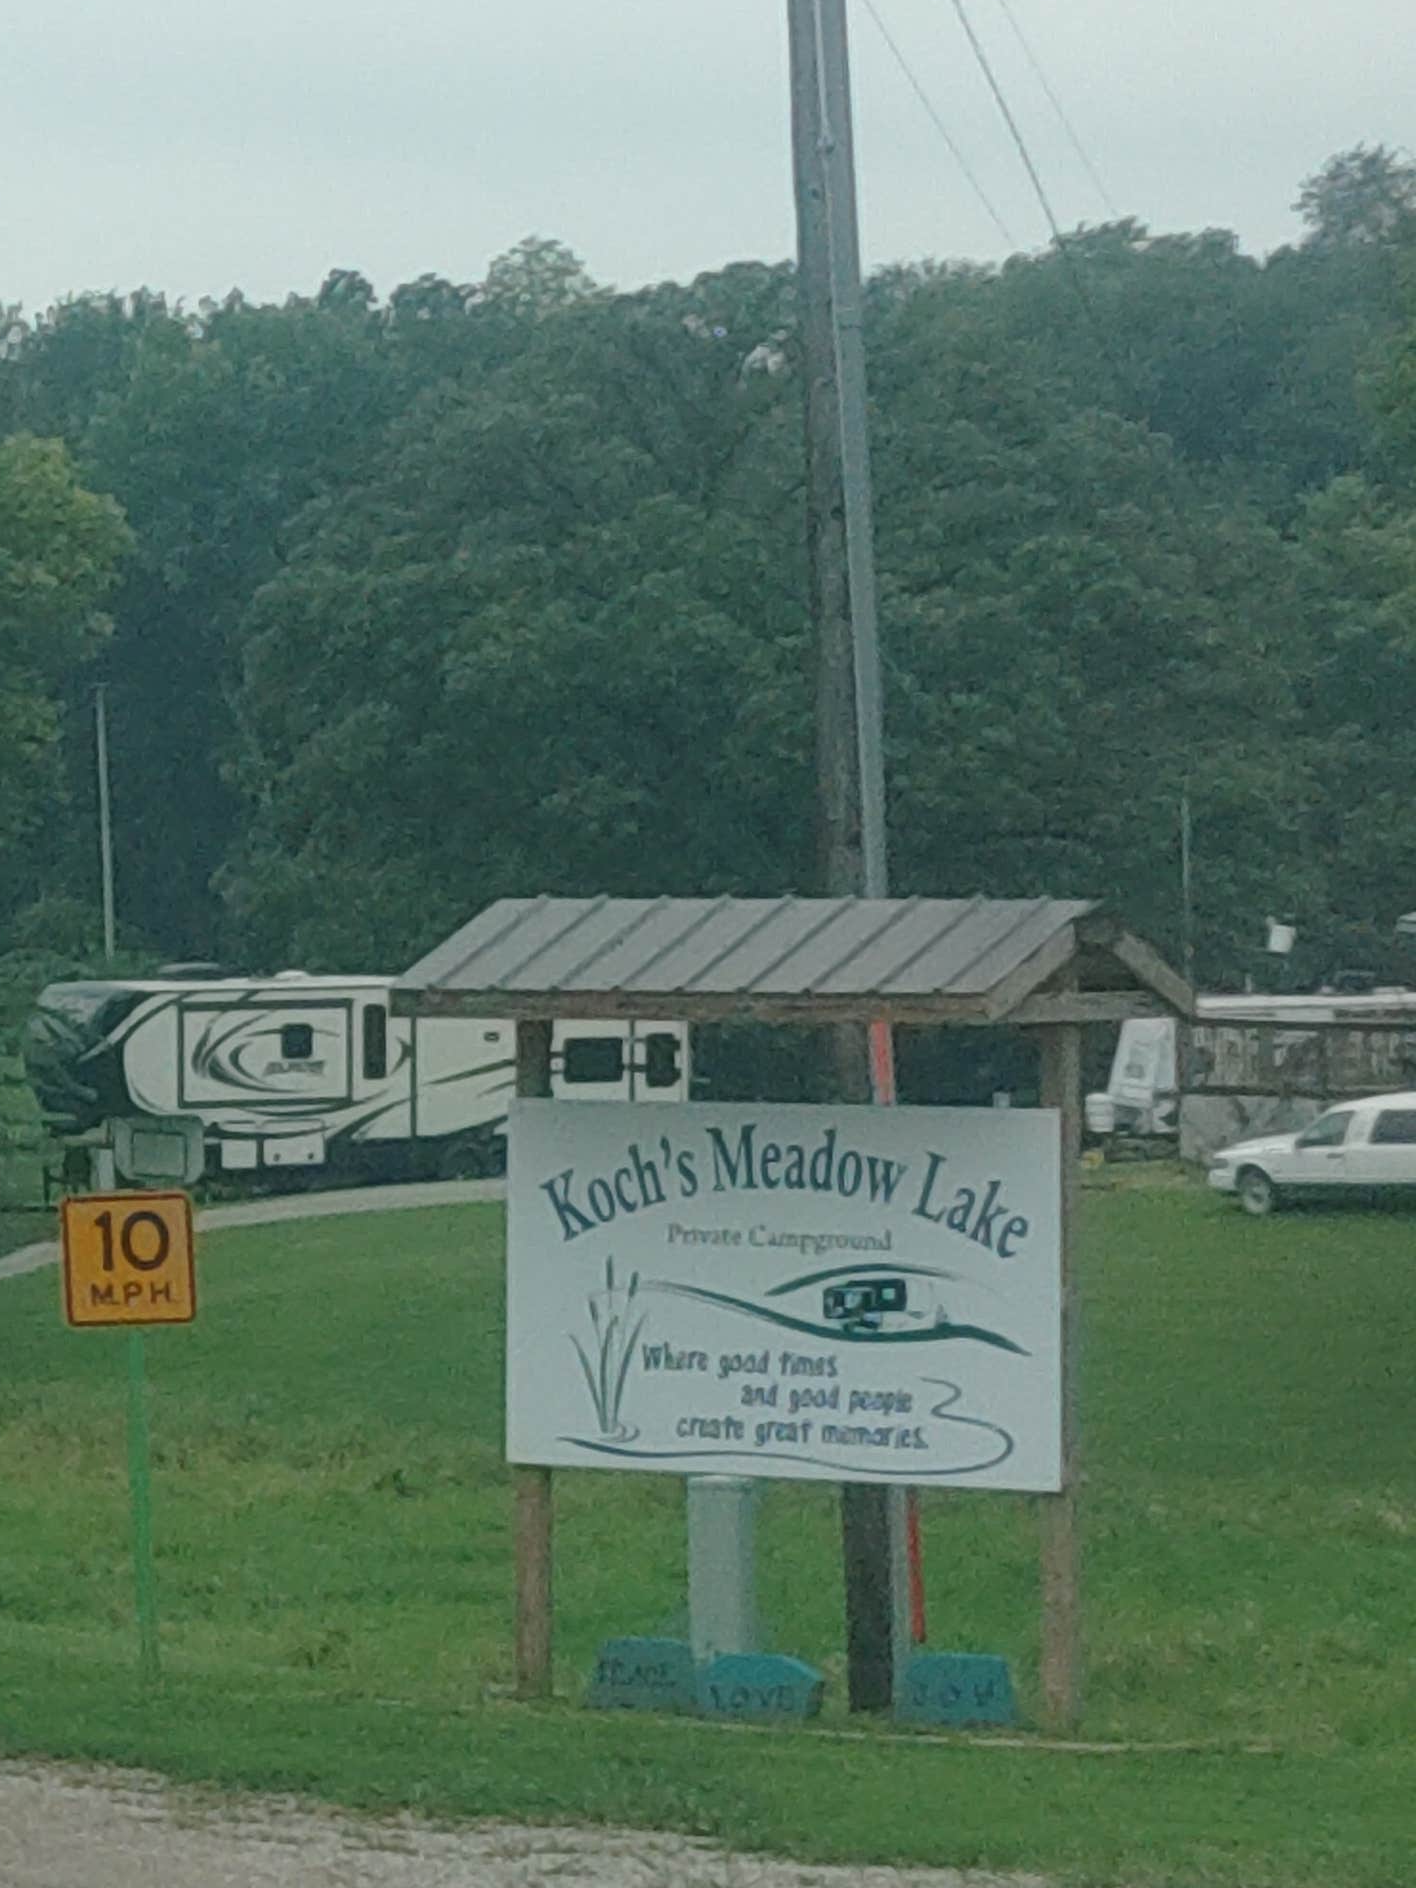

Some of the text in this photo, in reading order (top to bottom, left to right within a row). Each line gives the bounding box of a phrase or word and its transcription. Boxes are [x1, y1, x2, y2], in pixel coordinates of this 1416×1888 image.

[539, 1123, 1029, 1258] Koch's Meadow Lake
[94, 1210, 169, 1271] 10
[667, 1222, 893, 1255] Private Campground
[642, 1342, 838, 1378] Where good times
[740, 1383, 913, 1415] and good people
[676, 1416, 745, 1440] create
[754, 1418, 813, 1447] great
